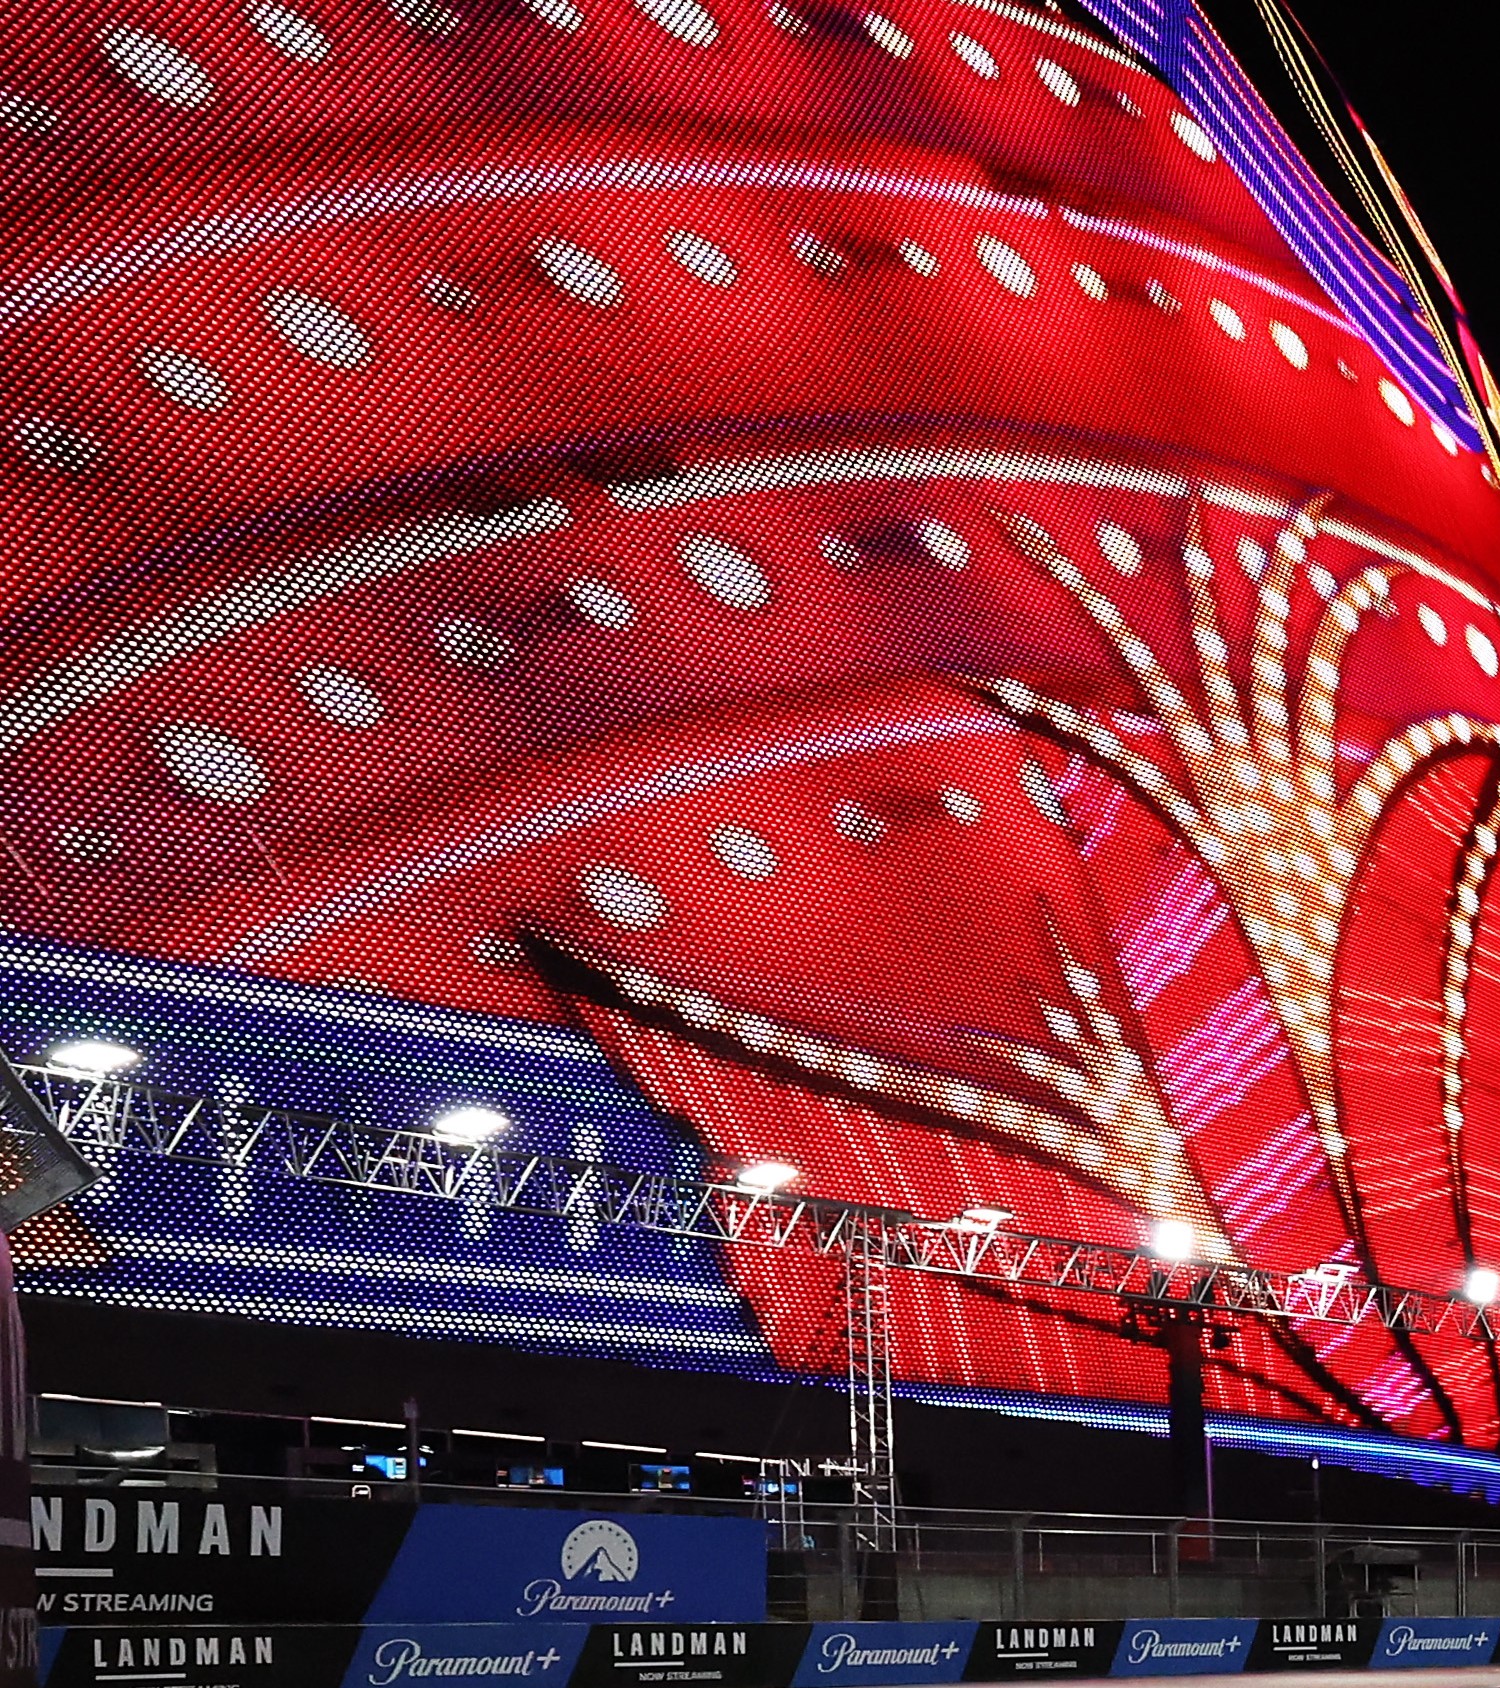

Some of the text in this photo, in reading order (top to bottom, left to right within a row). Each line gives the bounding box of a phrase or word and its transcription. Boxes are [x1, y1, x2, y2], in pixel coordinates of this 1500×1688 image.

[30, 1496, 282, 1557] NDMAN
[62, 1593, 214, 1612] STREAMING
[516, 1578, 675, 1617] Paramount+
[613, 1631, 746, 1657] LANDMAN
[996, 1627, 1095, 1650] LANDMAN
[1128, 1629, 1242, 1664] Paramount+
[1272, 1624, 1357, 1644] LANDMAN
[1385, 1625, 1489, 1657] Paramount+
[93, 1636, 273, 1668] LANDMAN
[368, 1638, 561, 1686] Paramount+
[817, 1633, 960, 1673] Paramount+
